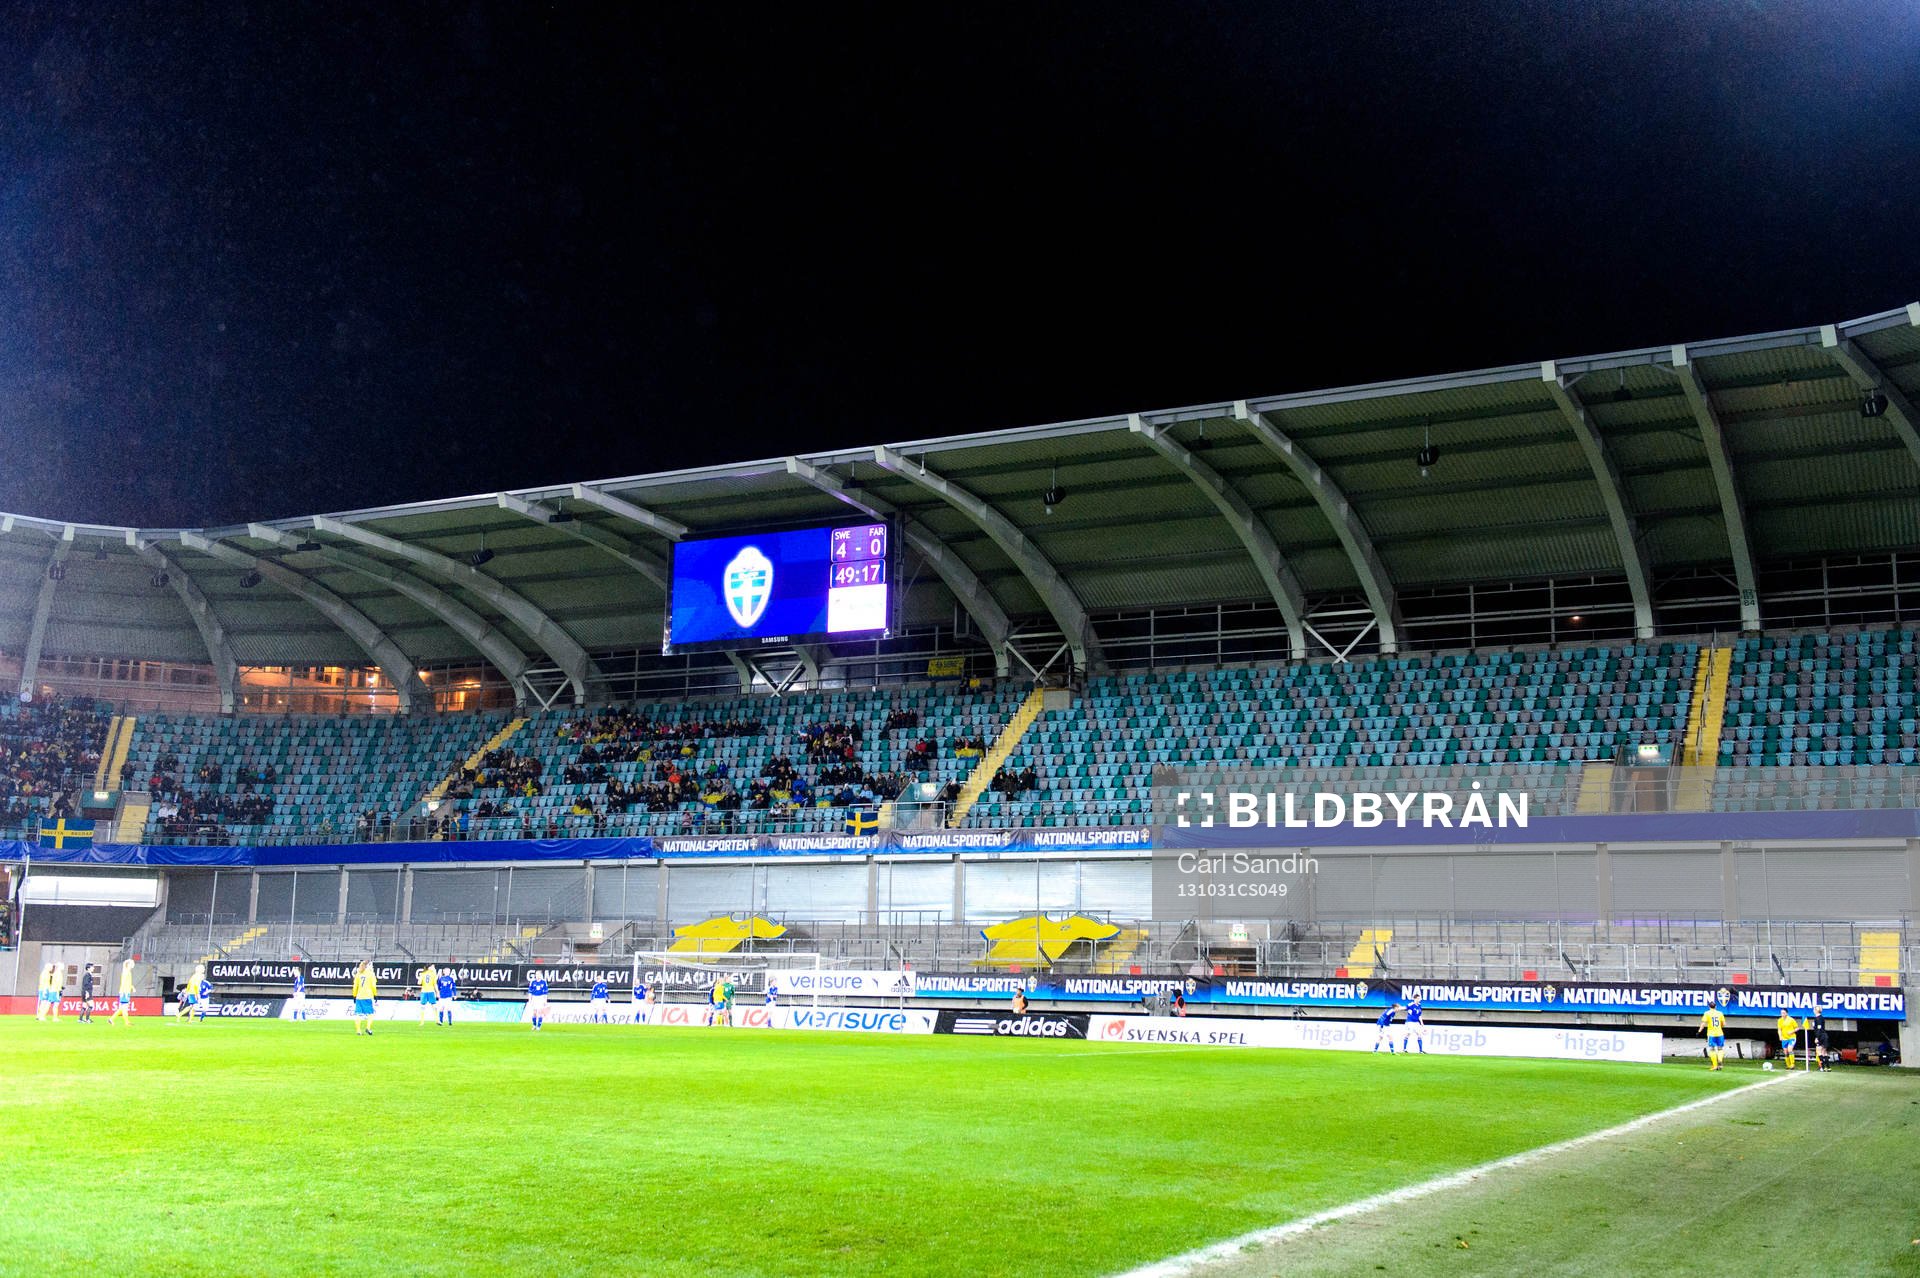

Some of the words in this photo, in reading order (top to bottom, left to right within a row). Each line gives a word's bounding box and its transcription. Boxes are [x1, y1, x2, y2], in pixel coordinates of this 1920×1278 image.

[835, 531, 851, 540] SWE
[869, 528, 884, 536] FAR
[836, 542, 847, 558] 4
[871, 539, 881, 555] 0
[835, 564, 880, 584] 49:17
[663, 839, 750, 852] NATIONALSPORTEN
[779, 837, 870, 850] NATIONALSPORTEN
[903, 834, 1001, 848] NATIONALSPORTEN
[1034, 831, 1139, 846] NATIONALSPORTEN
[212, 965, 251, 977] GAMLA
[311, 967, 353, 979] GAMLA
[470, 968, 513, 982] ULLEVI
[645, 971, 693, 984] GAMLA
[916, 976, 1026, 993] NATIONALSPORTEN
[1065, 978, 1184, 995] NATIONALSPORTEN
[1226, 981, 1355, 999] NATIONALSPORTEN
[1401, 985, 1542, 1003] NATIONALSPORTEN
[1563, 988, 1715, 1006] NATIONALSPORTEN
[1738, 991, 1903, 1011] NATIONALSPORTEN
[221, 1001, 269, 1016] adidas
[661, 1007, 689, 1024] ICA
[793, 1010, 907, 1030] verisure
[998, 1016, 1067, 1036] adidas
[1711, 1016, 1719, 1027] 15
[1126, 1028, 1201, 1043] SVENSKA
[1208, 1032, 1247, 1045] SPEL
[1302, 1023, 1356, 1046] higab
[1429, 1028, 1487, 1051] higab
[1565, 1033, 1625, 1056] higab
